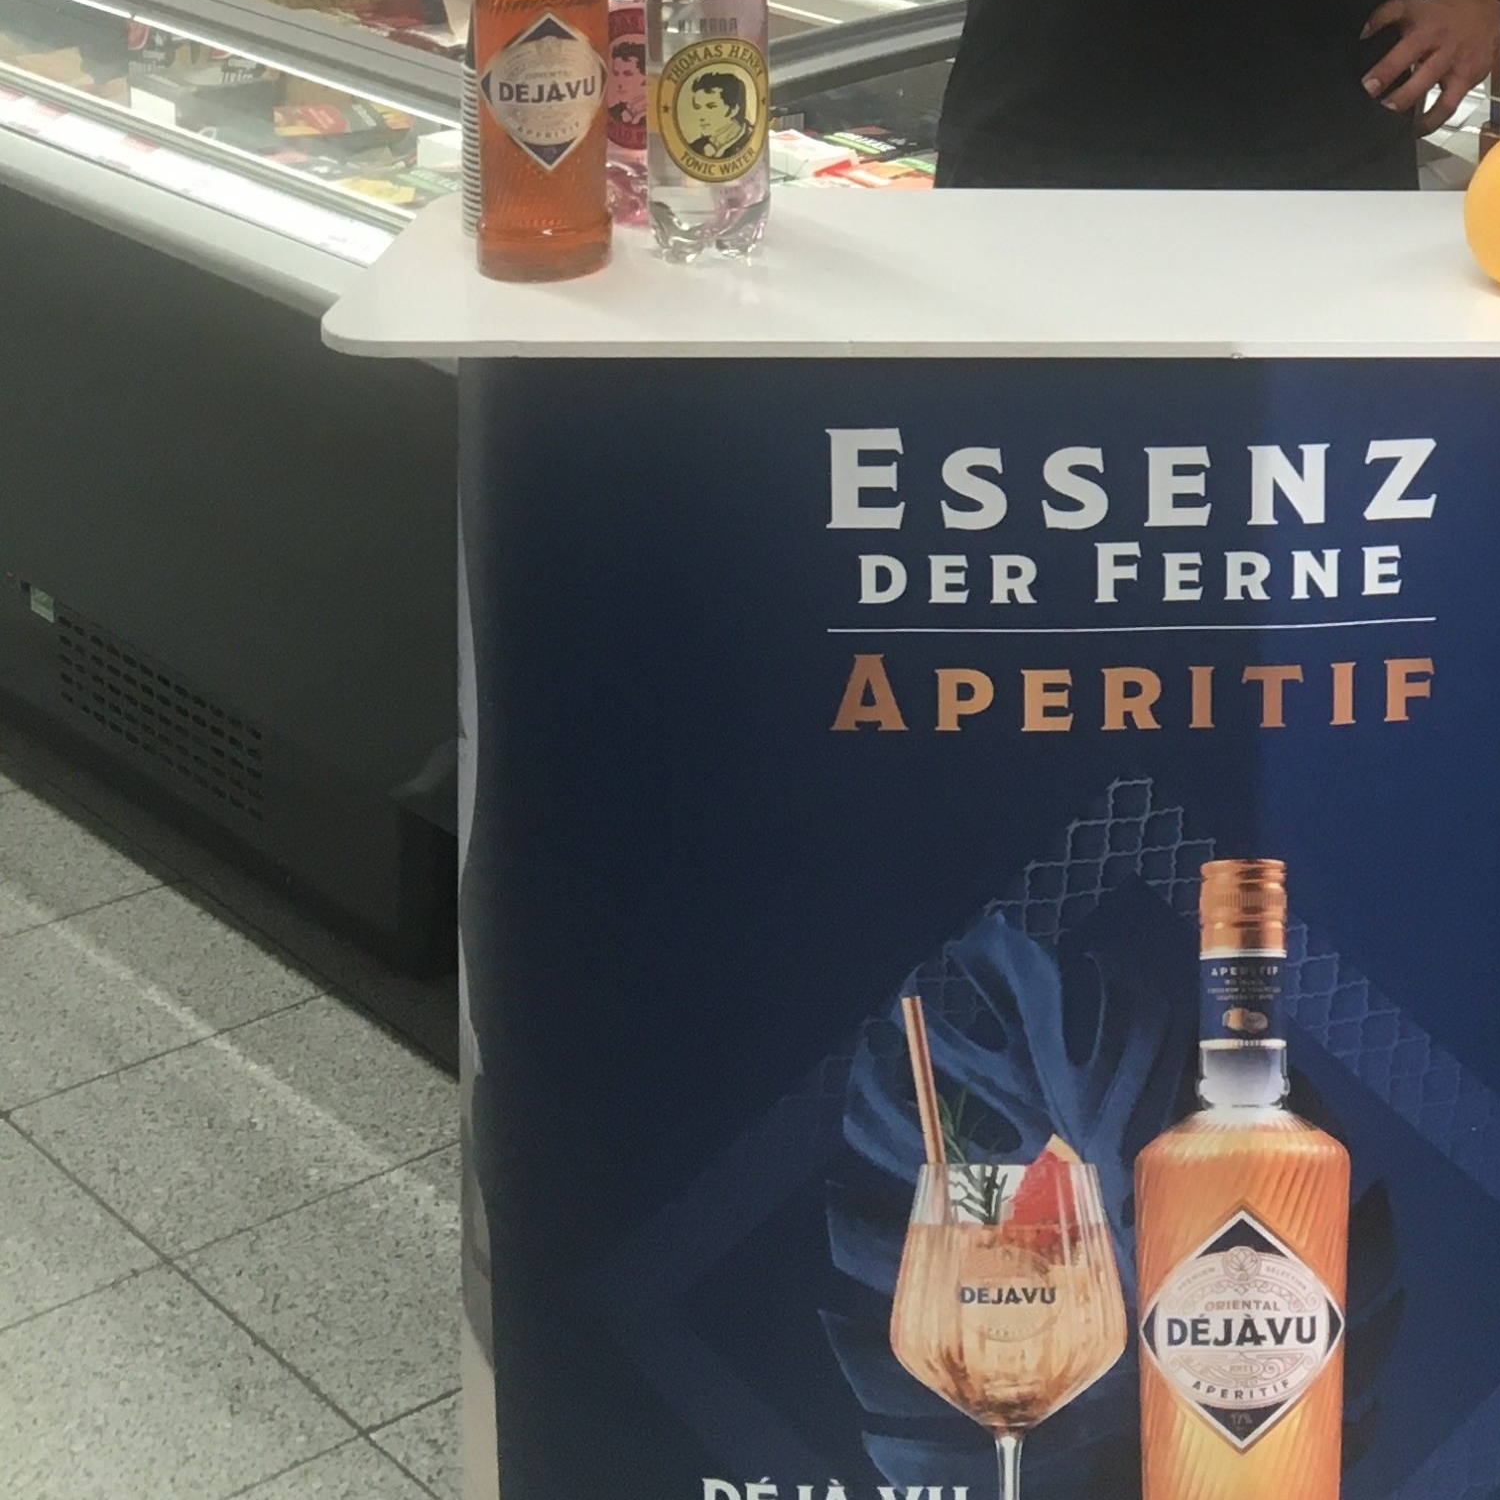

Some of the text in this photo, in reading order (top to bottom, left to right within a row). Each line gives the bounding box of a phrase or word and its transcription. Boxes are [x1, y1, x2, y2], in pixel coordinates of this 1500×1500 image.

[665, 44, 764, 86] THOMAS HENRY
[679, 148, 756, 177] TONIC WATER
[825, 426, 1438, 531] ESSENZ
[858, 541, 1403, 604] DER FERNE
[829, 653, 1435, 732] APERITIF
[1204, 1300, 1282, 1312] ORIENTAL
[1191, 1380, 1290, 1400] APERITIF
